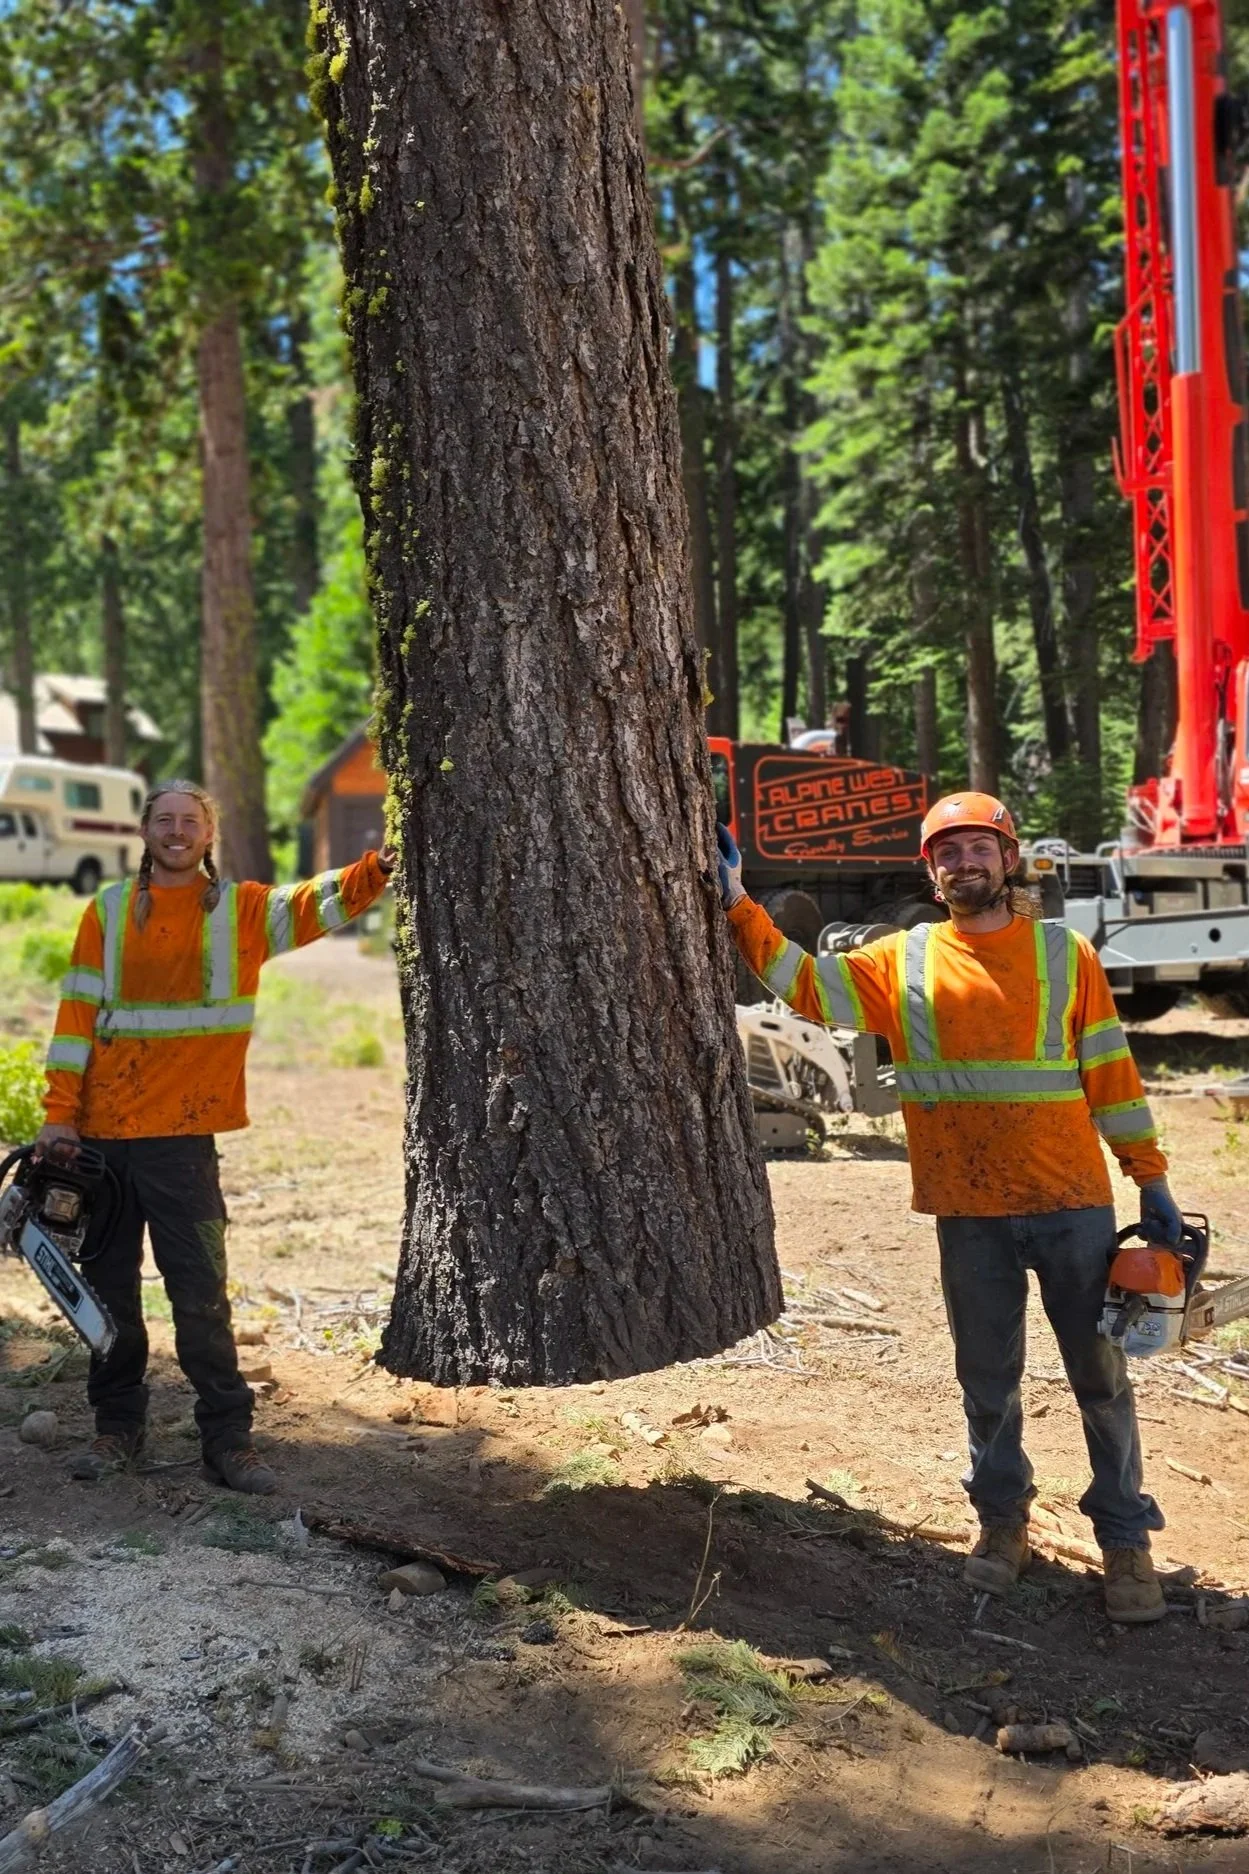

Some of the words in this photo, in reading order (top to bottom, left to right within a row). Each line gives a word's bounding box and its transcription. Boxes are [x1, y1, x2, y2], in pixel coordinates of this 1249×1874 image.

[769, 777, 845, 806] ALPINE
[848, 767, 904, 792] WEST
[773, 793, 912, 832] CRANES
